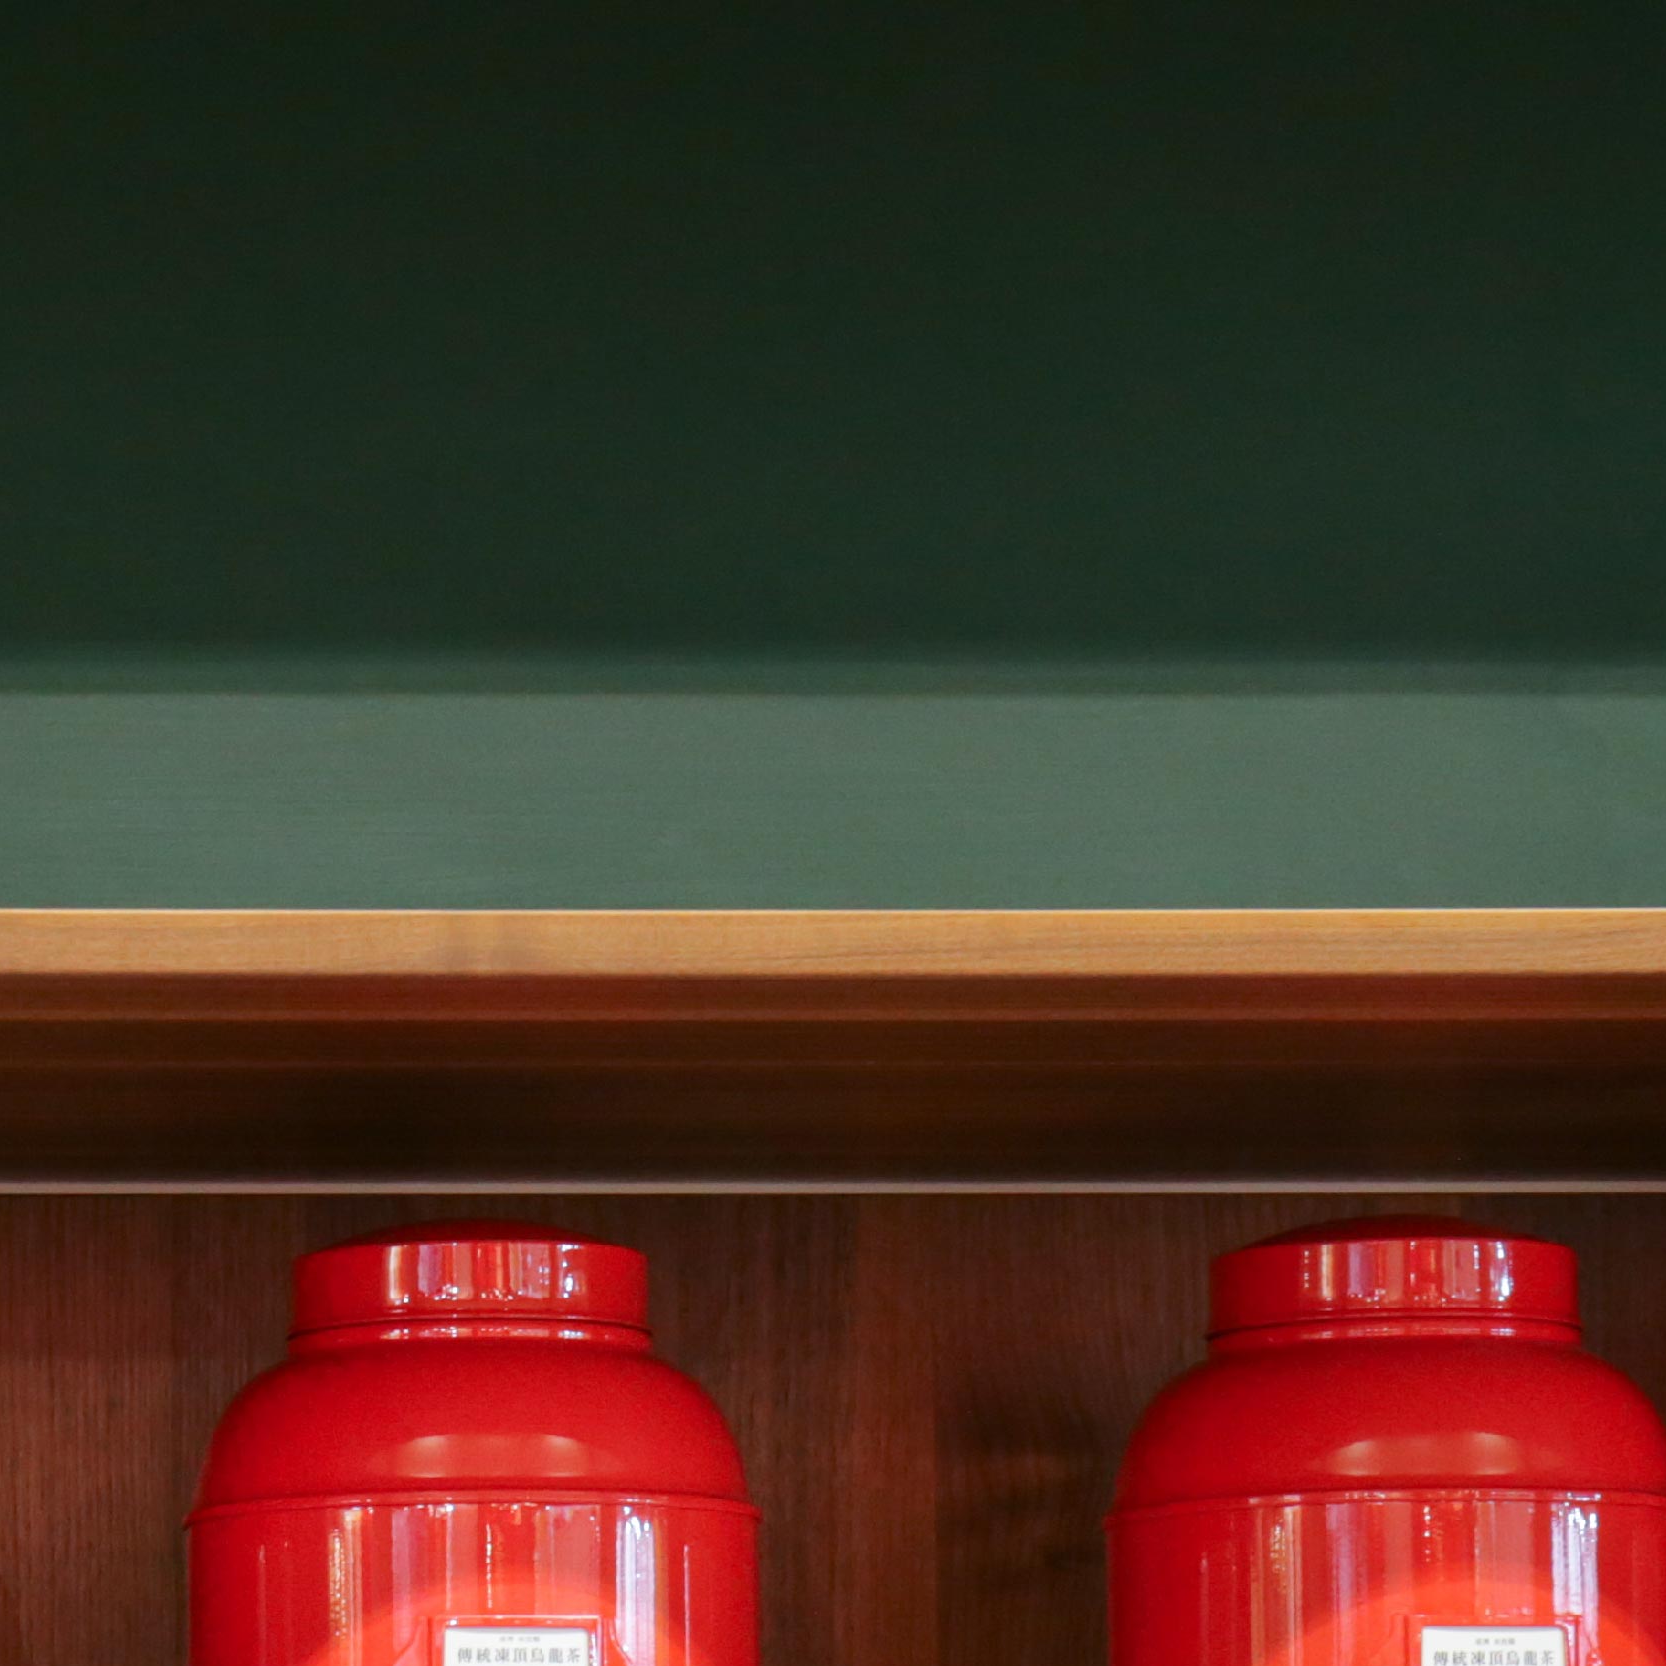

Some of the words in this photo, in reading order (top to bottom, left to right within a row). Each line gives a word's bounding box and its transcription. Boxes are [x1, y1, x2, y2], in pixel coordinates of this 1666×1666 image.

[457, 1648, 582, 1665] 傳統凍頂烏龍茶
[1433, 1650, 1556, 1666] 傳統凍頂烏龍茶
